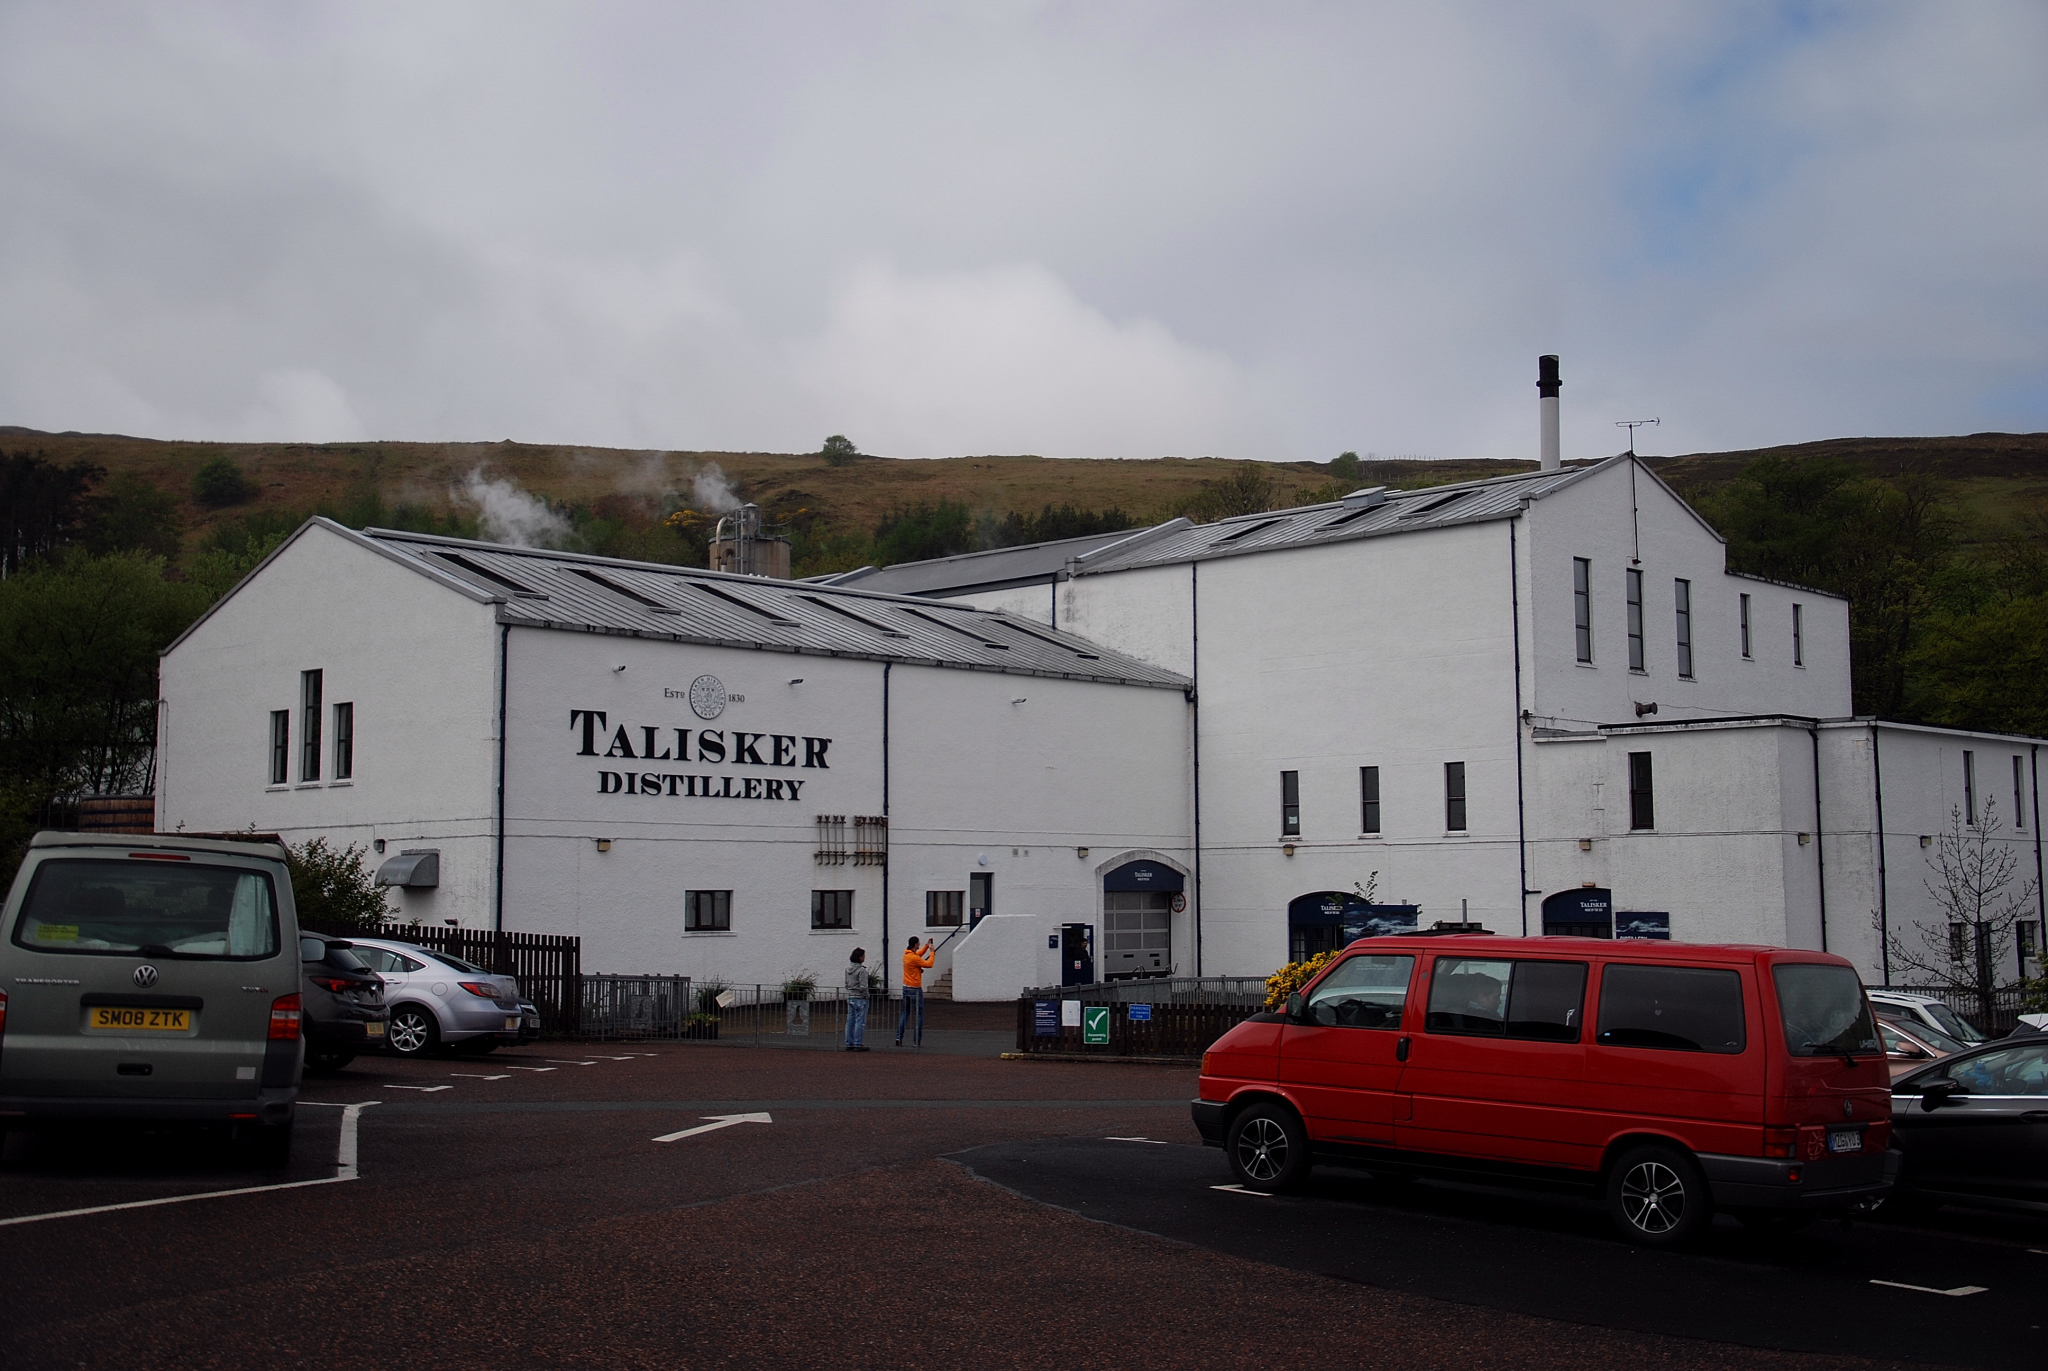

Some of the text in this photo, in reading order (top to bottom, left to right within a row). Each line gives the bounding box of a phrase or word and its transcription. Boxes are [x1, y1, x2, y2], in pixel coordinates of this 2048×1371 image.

[728, 693, 746, 703] 1830
[570, 709, 831, 769] TALISKER
[597, 771, 806, 801] DISTILLERY
[98, 1010, 185, 1027] SM08 ZTK
